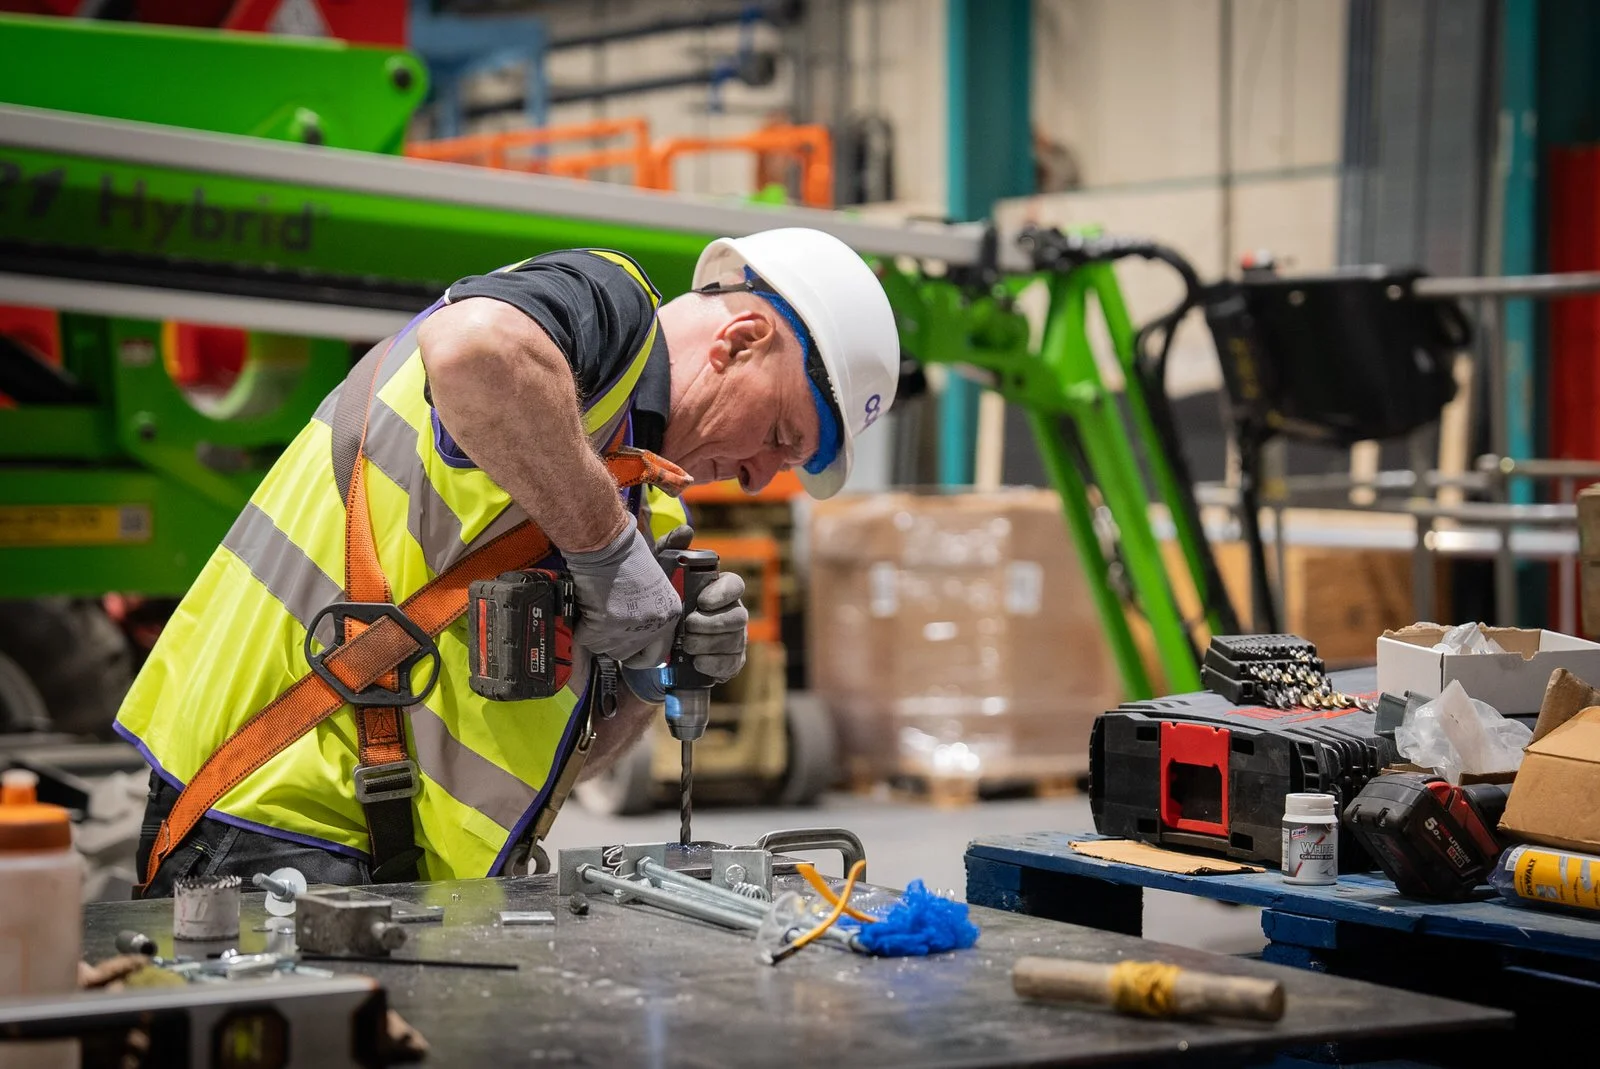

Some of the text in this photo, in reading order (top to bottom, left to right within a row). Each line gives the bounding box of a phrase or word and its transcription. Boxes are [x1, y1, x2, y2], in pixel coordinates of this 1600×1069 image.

[100, 172, 313, 252] Hybrid
[530, 648, 539, 673] M18
[1300, 841, 1335, 854] WHITE
